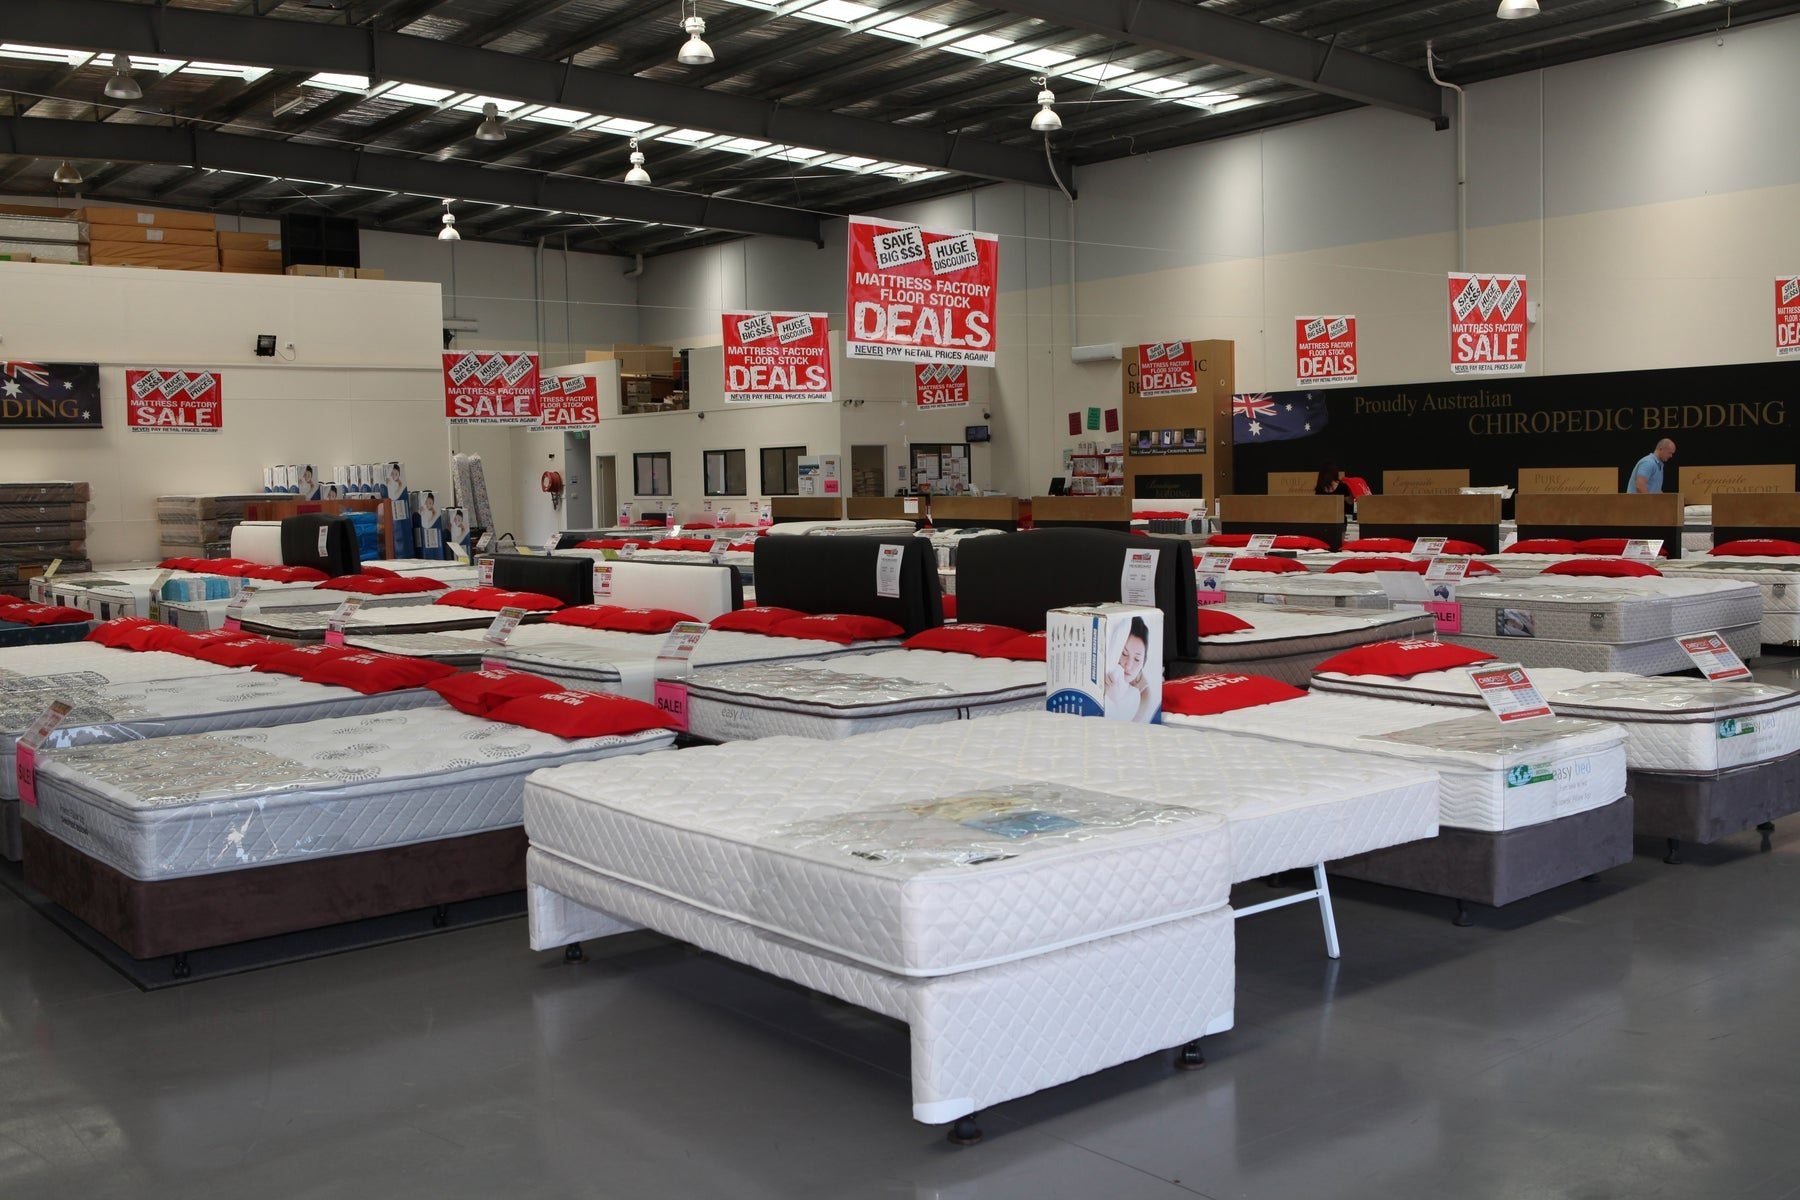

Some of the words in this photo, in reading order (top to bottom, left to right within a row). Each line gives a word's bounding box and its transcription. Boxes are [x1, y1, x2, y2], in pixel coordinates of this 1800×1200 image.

[882, 232, 915, 250] SAVE
[936, 240, 969, 258] HUGE
[880, 250, 900, 265] BIG
[900, 244, 923, 260] $$$
[934, 252, 976, 271] DISCOUNTS
[855, 272, 932, 291] MATTRESS
[936, 280, 990, 296] FACTORY
[880, 288, 924, 305] FLOOR
[929, 293, 970, 308] STOCK
[1458, 282, 1476, 307] SAVE
[1481, 284, 1498, 308] HUGE
[1502, 287, 1521, 318] PRICES
[1458, 304, 1470, 318] BIG
[742, 330, 755, 341] BIG
[756, 325, 773, 336] $$$
[744, 317, 768, 331] SAVE
[782, 319, 806, 332] HUGE
[854, 301, 991, 347] DEALS
[1330, 320, 1344, 331] HUGE
[1452, 323, 1494, 334] MATTRESS
[1494, 323, 1523, 332] FACTORY
[780, 326, 812, 341] DISCOUNTS
[728, 346, 780, 355] MATTRESS
[782, 347, 824, 356] FACTORY
[854, 345, 883, 357] NEVER
[886, 347, 902, 356] PAY
[904, 348, 932, 358] RETAIL
[935, 350, 962, 360] PRICES
[964, 352, 988, 361] AGAIN!
[1299, 342, 1330, 350] MATTRESS
[1328, 348, 1346, 356] STOCK
[1457, 333, 1519, 362] SALE
[453, 357, 474, 375] SAVE
[480, 356, 500, 376] HUGE
[744, 356, 774, 365] FLOOR
[778, 356, 809, 365] STOCK
[1299, 354, 1355, 376] DEALS
[136, 372, 156, 390] SAVE
[454, 371, 468, 383] BIG
[507, 361, 531, 383] PRICES
[728, 364, 827, 391] DEALS
[1142, 370, 1193, 390] DEALS
[163, 374, 182, 391] HUGE
[190, 379, 214, 398] PRICES
[448, 387, 496, 395] MATTRESS
[498, 387, 536, 395] FACTORY
[564, 379, 581, 388] HUGE
[180, 400, 218, 408] FACTORY
[922, 388, 964, 404] SALE
[1354, 394, 1418, 416] Proudly
[1422, 390, 1513, 412] Australian
[454, 395, 531, 416] SALE
[137, 406, 212, 426] SALE
[1468, 406, 1634, 436] CHIROPEDIC
[1642, 400, 1786, 430] BEDDING
[1192, 682, 1228, 691] NOW
[1226, 676, 1250, 684] ON
[562, 698, 585, 706] ON
[657, 696, 683, 714] SALE!
[721, 708, 739, 721] easy
[1552, 766, 1572, 782] easy
[1574, 758, 1592, 776] bed
